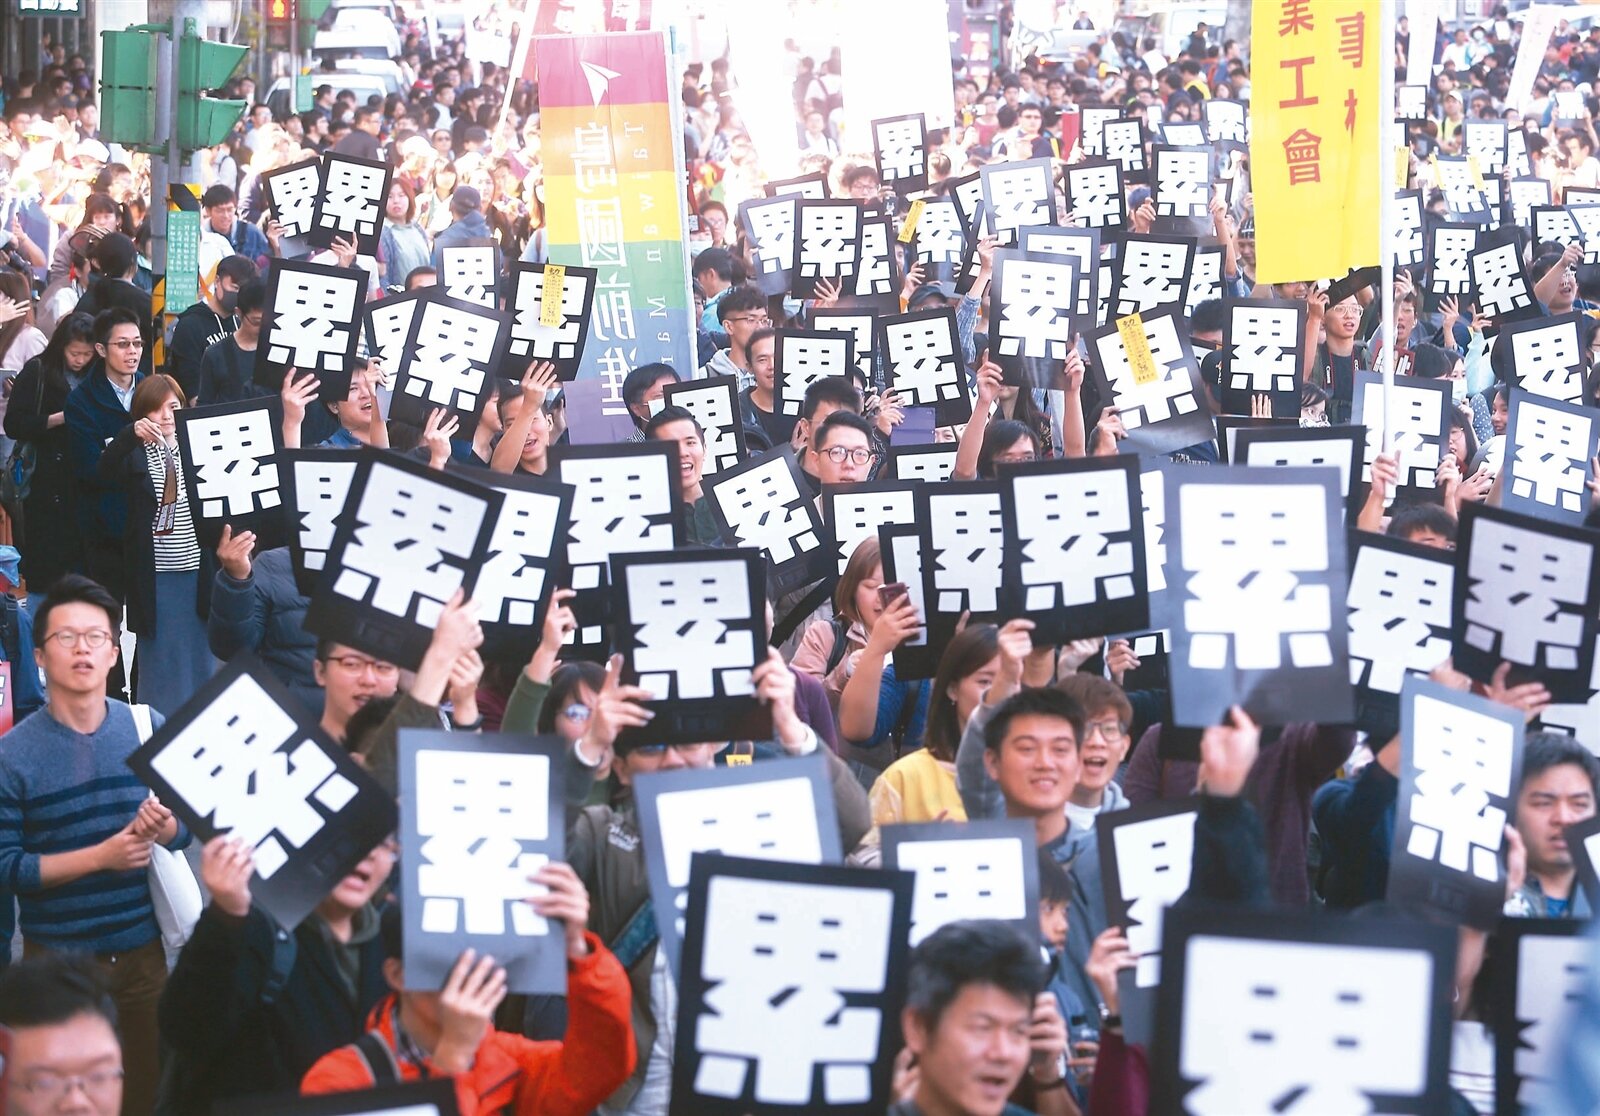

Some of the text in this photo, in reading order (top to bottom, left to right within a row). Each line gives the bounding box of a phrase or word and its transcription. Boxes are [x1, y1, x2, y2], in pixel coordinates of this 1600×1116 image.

[877, 119, 923, 180] 累
[1069, 165, 1121, 228] 累
[1103, 121, 1142, 171] 累
[1158, 151, 1208, 216] 累
[1466, 124, 1504, 174] 累
[269, 164, 320, 238] 累
[320, 160, 386, 235] 累
[801, 206, 857, 277] 累
[917, 202, 962, 265] 累
[988, 166, 1050, 244] 累
[999, 259, 1072, 360] 累
[1117, 241, 1188, 315] 累
[1433, 229, 1476, 293] 累
[1473, 243, 1531, 318] 累
[267, 269, 358, 371] 累
[404, 302, 500, 411] 累
[509, 271, 587, 359] 累
[886, 317, 960, 406] 累
[1231, 307, 1298, 391] 累
[1512, 322, 1583, 405] 累
[1096, 314, 1198, 429] 累
[186, 409, 281, 517] 累
[1362, 382, 1443, 488] 累
[1512, 401, 1592, 512] 累
[333, 462, 488, 629] 累
[561, 455, 674, 589] 累
[713, 456, 820, 565] 累
[930, 494, 1003, 612] 累
[1013, 469, 1134, 610] 累
[1180, 484, 1332, 669] 累
[1346, 546, 1455, 694] 累
[1465, 517, 1593, 669] 累
[626, 559, 754, 700] 累
[150, 673, 359, 880] 累
[1408, 694, 1514, 882] 累
[416, 750, 549, 935] 累
[695, 875, 894, 1104] 累
